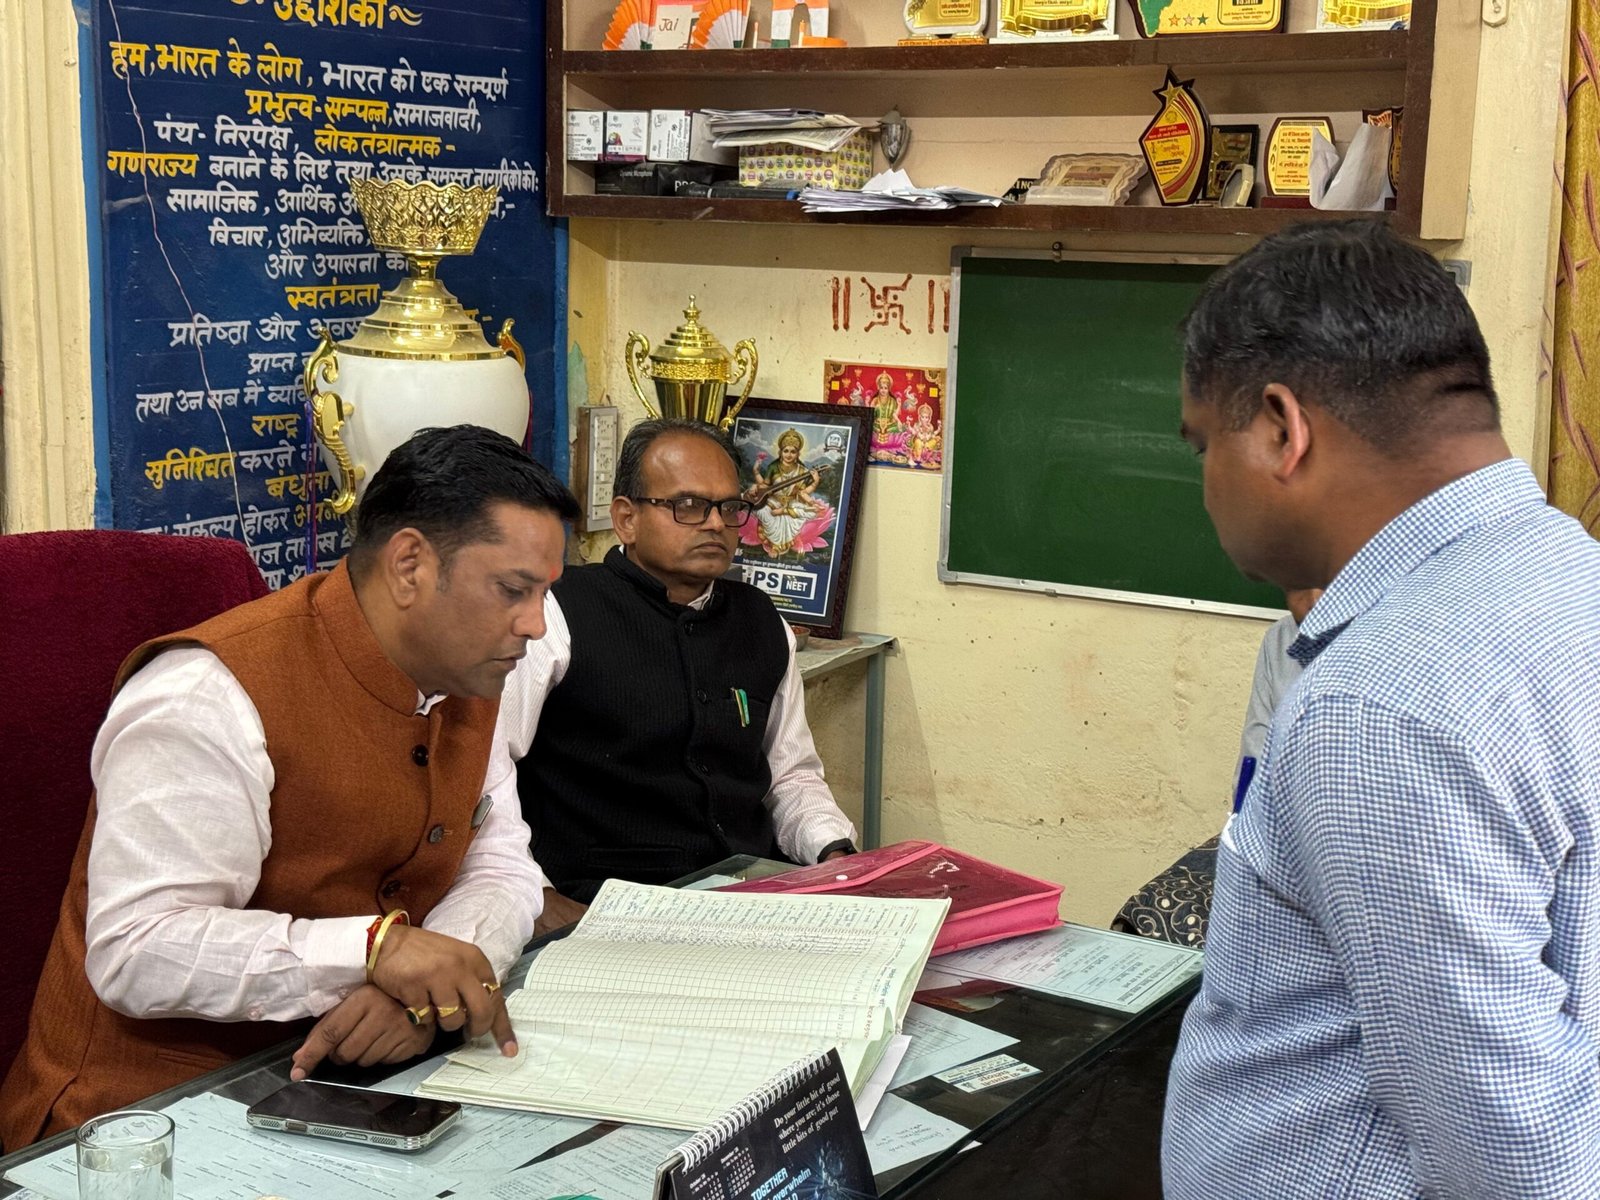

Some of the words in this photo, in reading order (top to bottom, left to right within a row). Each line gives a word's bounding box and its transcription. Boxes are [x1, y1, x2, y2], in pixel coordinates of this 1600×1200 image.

[658, 17, 679, 32] Jai
[155, 43, 221, 79] भारत
[226, 37, 251, 78] के
[256, 42, 313, 88] लोग,
[319, 61, 388, 94] भारत
[390, 57, 417, 94] को
[420, 71, 451, 96] एक
[453, 67, 509, 102] सम्पूर्ण
[106, 150, 200, 178] गणराज्य
[208, 149, 267, 180] बनाने
[269, 151, 294, 181] के
[293, 152, 331, 182] लिए
[274, 184, 336, 215] आर्थिक
[208, 216, 273, 249] विचार,
[265, 248, 308, 280] और
[312, 252, 381, 278] उपासना
[284, 277, 381, 311] स्वतंत्रता
[167, 312, 251, 348] प्रतिष्ठा
[255, 312, 302, 342] और
[248, 352, 297, 375] प्राप्त
[135, 392, 174, 424] तथा
[175, 389, 204, 413] उन
[243, 378, 265, 406] में
[251, 413, 301, 439] राष्ट्र
[238, 439, 297, 472] करने
[242, 504, 291, 544] होकर
[786, 579, 808, 593] NEET
[773, 1118, 784, 1128] Do
[784, 1107, 796, 1124] your
[796, 1096, 810, 1111] little
[809, 1090, 819, 1101] bit
[819, 1082, 825, 1094] of
[826, 1073, 841, 1092] good
[778, 1124, 795, 1140] where
[795, 1117, 806, 1131] you
[825, 1090, 840, 1105] those
[781, 1138, 797, 1154] little
[796, 1130, 808, 1143] bits
[808, 1122, 814, 1134] of
[815, 1112, 830, 1131] good
[829, 1106, 839, 1121] put
[751, 1167, 789, 1200] TOGETHER
